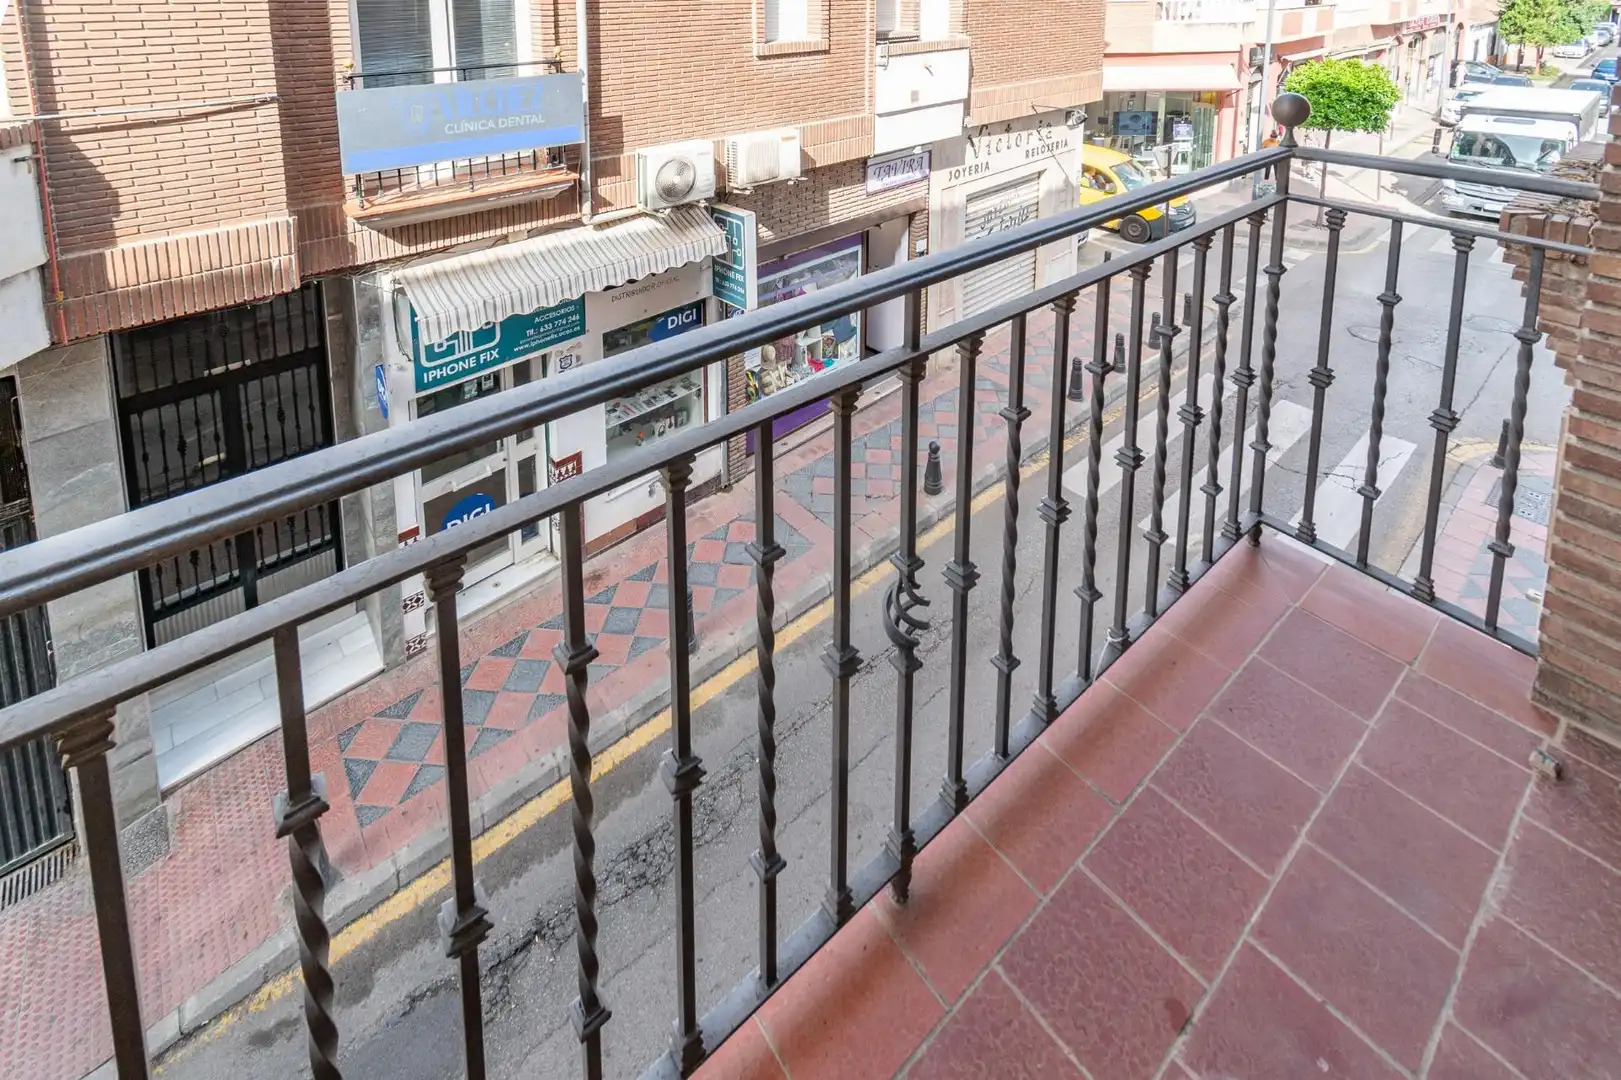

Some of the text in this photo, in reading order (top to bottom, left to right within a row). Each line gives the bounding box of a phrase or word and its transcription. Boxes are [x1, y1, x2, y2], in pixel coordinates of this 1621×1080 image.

[444, 113, 545, 135] CLÍNICA DENTAL
[873, 155, 925, 181] TAVIRA
[948, 160, 991, 182] JOYERIA
[534, 304, 576, 324] ACCESORIOS
[539, 322, 553, 333] 633
[553, 317, 567, 328] 774
[567, 313, 580, 324] 246
[667, 308, 697, 330] DIGI
[423, 348, 499, 384] IPHONE FIX
